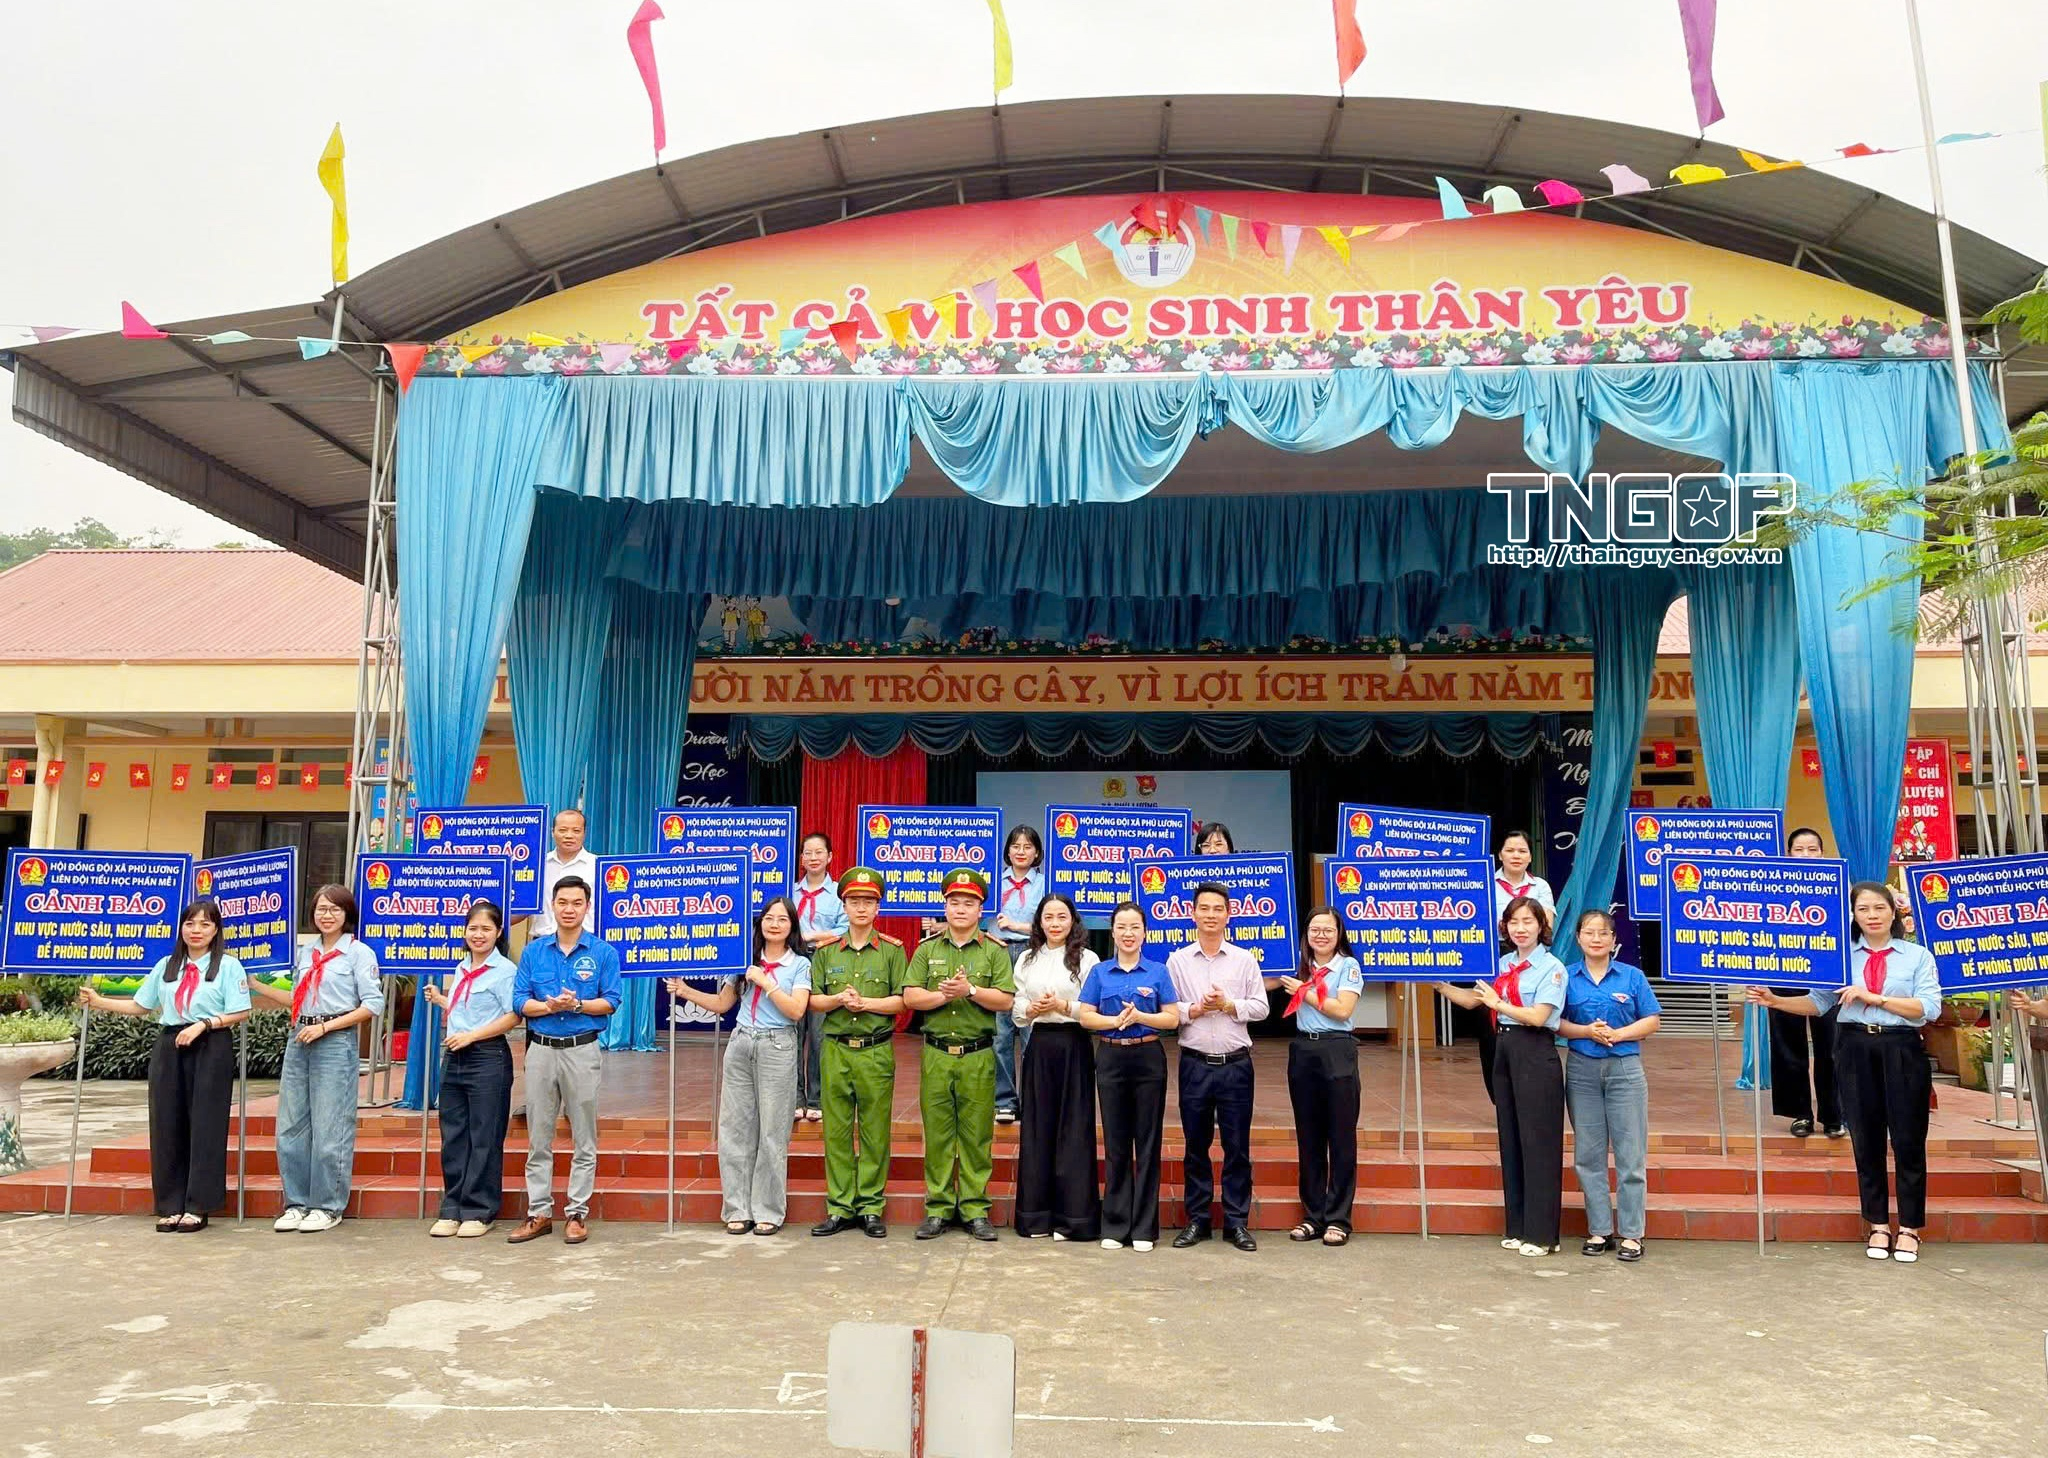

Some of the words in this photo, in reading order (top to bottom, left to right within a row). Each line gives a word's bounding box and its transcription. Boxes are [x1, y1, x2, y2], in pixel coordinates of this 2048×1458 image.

[641, 285, 777, 341] TẤT
[794, 288, 883, 341] CẢ
[900, 290, 973, 341] VÌ
[996, 300, 1128, 353] HỌC
[1148, 295, 1312, 337] SINH
[1328, 280, 1524, 332] THÂN
[1542, 276, 1689, 327] YÊU
[689, 666, 752, 703] ƯỜI
[763, 665, 855, 702] NĂM
[865, 664, 1004, 703] TRỒNG
[1014, 665, 1105, 705] CÂY,
[1117, 665, 1162, 702] VÌ
[1174, 668, 1244, 710] LỢI
[1255, 665, 1328, 702] ÍCH
[1469, 664, 1565, 701] NĂM
[683, 762, 729, 780] Học
[1904, 783, 1945, 801] LUYỆN
[1913, 802, 1939, 818] ĐỨC
[894, 828, 908, 836] LIÊN
[909, 828, 922, 837] ĐỘI
[939, 830, 954, 838] HỌC
[978, 829, 992, 837] TIÊN
[875, 841, 937, 862] CẢNH
[939, 843, 985, 863] BÁO
[50, 862, 66, 872] HỘI
[97, 863, 113, 874] ĐỘI
[148, 865, 179, 874] LƯƠNG
[636, 867, 649, 877] HỘI
[672, 865, 685, 875] ĐỘI
[713, 864, 737, 872] LƯƠNG
[1379, 869, 1390, 879] HỘI
[1410, 868, 1422, 879] ĐỘI
[1444, 868, 1467, 877] LƯƠNG
[1704, 867, 1720, 879] HỘI
[1750, 869, 1767, 880] ĐỘI
[1804, 872, 1836, 881] LƯƠNG
[51, 874, 70, 883] LIÊN
[72, 874, 89, 886] ĐỘI
[111, 877, 130, 886] HỌC
[634, 879, 649, 888] LIÊN
[650, 878, 663, 888] ĐỘI
[664, 879, 681, 887] THCS
[683, 877, 709, 886] DƯƠNG
[721, 876, 739, 884] MINH
[1365, 882, 1378, 890] LIÊN
[1379, 881, 1390, 891] ĐỘI
[1407, 881, 1420, 891] NỘI
[1462, 881, 1483, 889] LƯƠNG
[1950, 874, 1966, 885] HỘI
[1995, 870, 2011, 880] ĐỘI
[1703, 880, 1723, 890] LIÊN
[1724, 881, 1741, 892] ĐỘI
[1764, 884, 1784, 894] HỌC
[1785, 884, 1813, 895] ĐỘNG
[1815, 886, 1833, 896] ĐẠT
[1957, 887, 1976, 897] LIÊN
[1977, 885, 1993, 896] ĐỘI
[2015, 882, 2034, 892] HỌC
[25, 888, 104, 914] CẢNH
[107, 892, 166, 915] BÁO
[613, 893, 680, 918] CẢNH
[683, 892, 733, 915] BÁO
[1346, 896, 1418, 920] CẢNH
[1422, 896, 1476, 920] BÁO
[1683, 895, 1763, 922] CẢNH
[1767, 900, 1827, 926] BÁO
[1937, 903, 2012, 930] CẢNH
[14, 922, 35, 935] KHU
[38, 922, 57, 939] VỰC
[60, 921, 88, 937] NƯỚC
[90, 921, 113, 938] SÂU,
[116, 924, 143, 938] NGUY
[145, 920, 171, 938] HIỂM
[606, 928, 623, 941] KHU
[625, 926, 642, 943] VỰC
[644, 924, 668, 940] NƯỚC
[669, 923, 689, 940] SÂU,
[692, 924, 715, 938] NGUY
[717, 919, 739, 937] HIỂM
[1346, 930, 1358, 943] HU
[1360, 929, 1379, 946] VỰC
[1381, 927, 1406, 943] NƯỚC
[1409, 927, 1431, 945] SÂU,
[1433, 930, 1458, 943] NGUY
[1460, 924, 1485, 943] HIỂM
[1676, 929, 1696, 943] KHU
[1699, 929, 1719, 947] VỰC
[1721, 929, 1749, 946] NƯỚC
[1752, 930, 1776, 949] SÂU,
[1779, 934, 1806, 949] NGUY
[1809, 931, 1836, 950] HIỂM
[1933, 941, 1954, 956] KHU
[1955, 938, 1976, 956] VỰC
[1977, 934, 2005, 951] NƯỚC
[2007, 932, 2031, 948] SÂU,
[53, 942, 88, 959] PHÒNG
[90, 942, 114, 959] ĐUỐI
[116, 944, 144, 959] NƯỚC
[640, 946, 669, 962] PHÒNG
[671, 943, 692, 961] ĐUỐI
[694, 944, 717, 960] NƯỚC
[1378, 949, 1410, 966] PHÒNG
[1411, 948, 1434, 966] ĐUỐI
[1436, 950, 1463, 966] NƯỚC
[1717, 952, 1752, 969] PHÒNG
[1755, 953, 1779, 971] ĐUỐI
[1782, 956, 1811, 973] NƯỚC
[1977, 957, 2012, 975] PHÒNG
[2013, 952, 2037, 972] ĐUỐI
